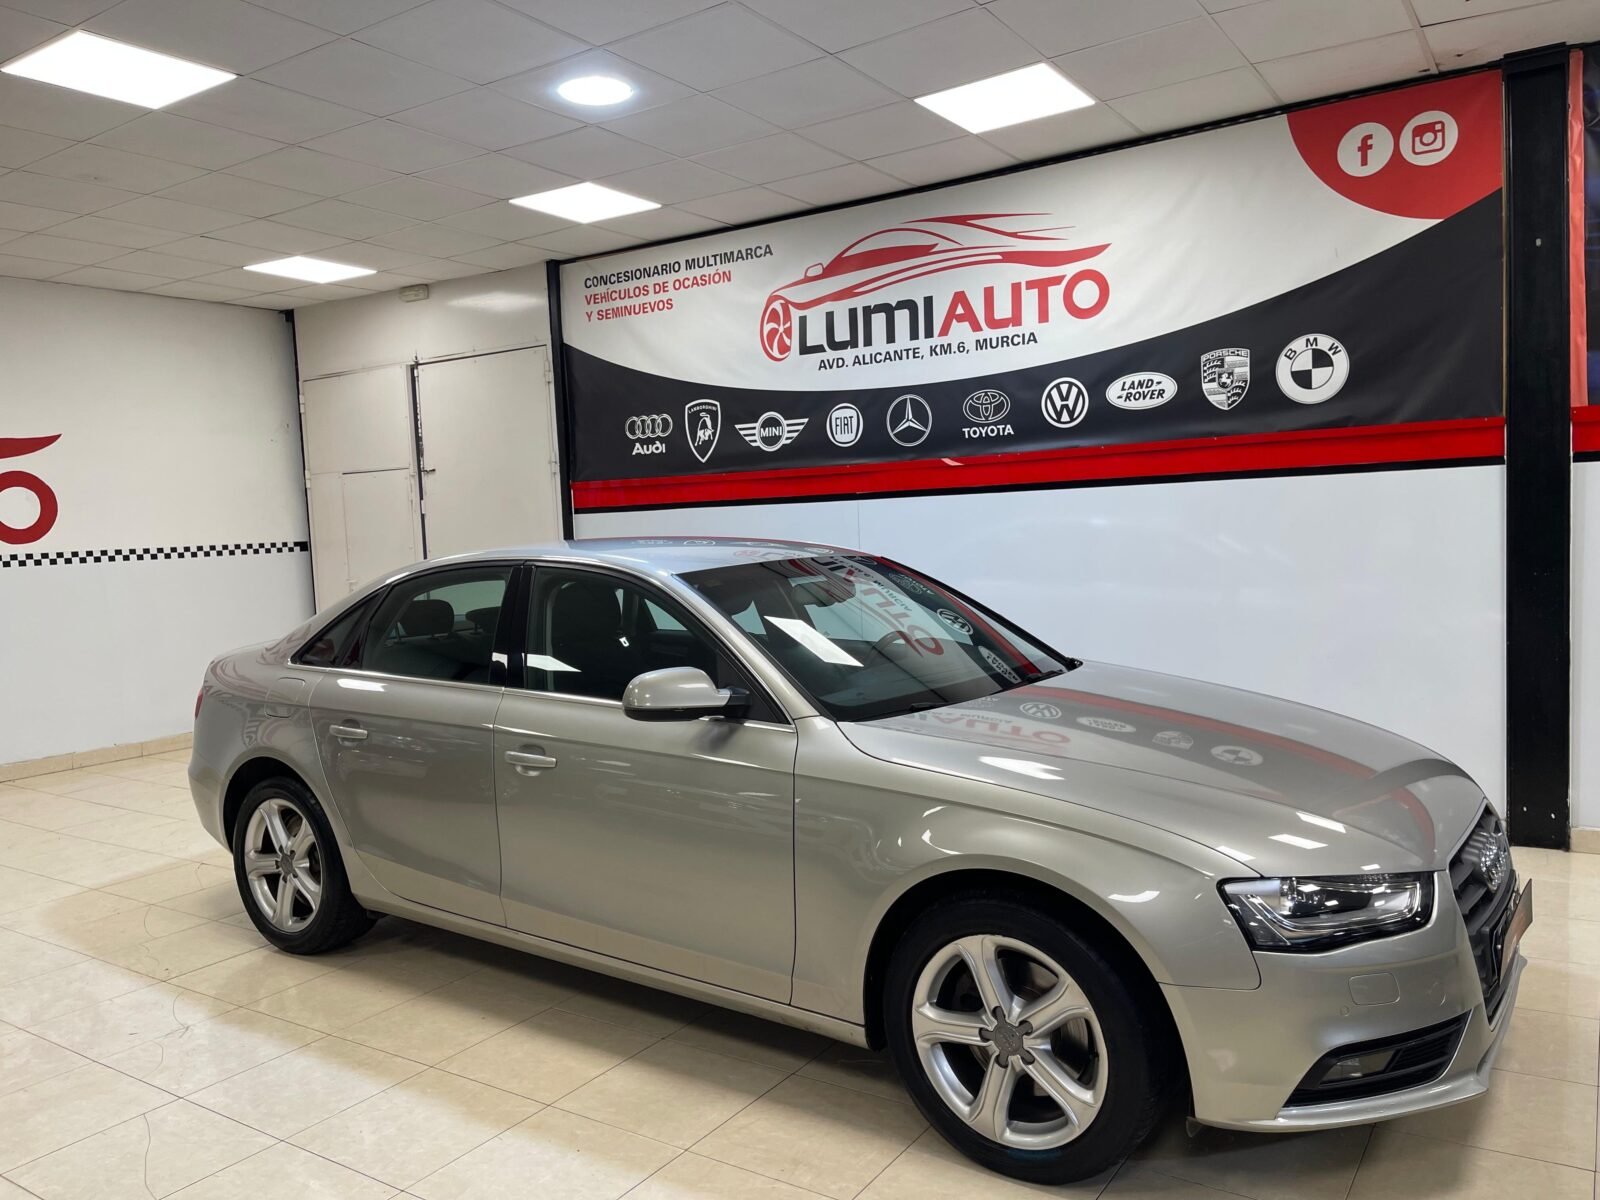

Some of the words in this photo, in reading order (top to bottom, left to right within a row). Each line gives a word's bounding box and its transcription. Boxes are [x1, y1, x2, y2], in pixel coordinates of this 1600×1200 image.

[584, 261, 681, 289] CONCESIONARIO
[685, 244, 774, 271] MULTIMARCA
[584, 284, 650, 306] VEHÍCULOS
[653, 281, 669, 295] DE
[672, 269, 733, 291] OCASIÓN
[585, 311, 593, 322] Y
[596, 298, 674, 321] SEMINUEVOS
[817, 356, 850, 372] AVD.
[852, 347, 924, 367] ALICANTE,
[929, 341, 970, 357] KM.6,
[975, 332, 1038, 351] MURCIA
[1202, 350, 1249, 361] PORSCHE
[1284, 336, 1342, 361] BMW
[760, 426, 783, 438] MINI
[835, 415, 855, 436] FIAT
[962, 424, 1014, 439] TOYOTA
[631, 441, 666, 456] Audi
